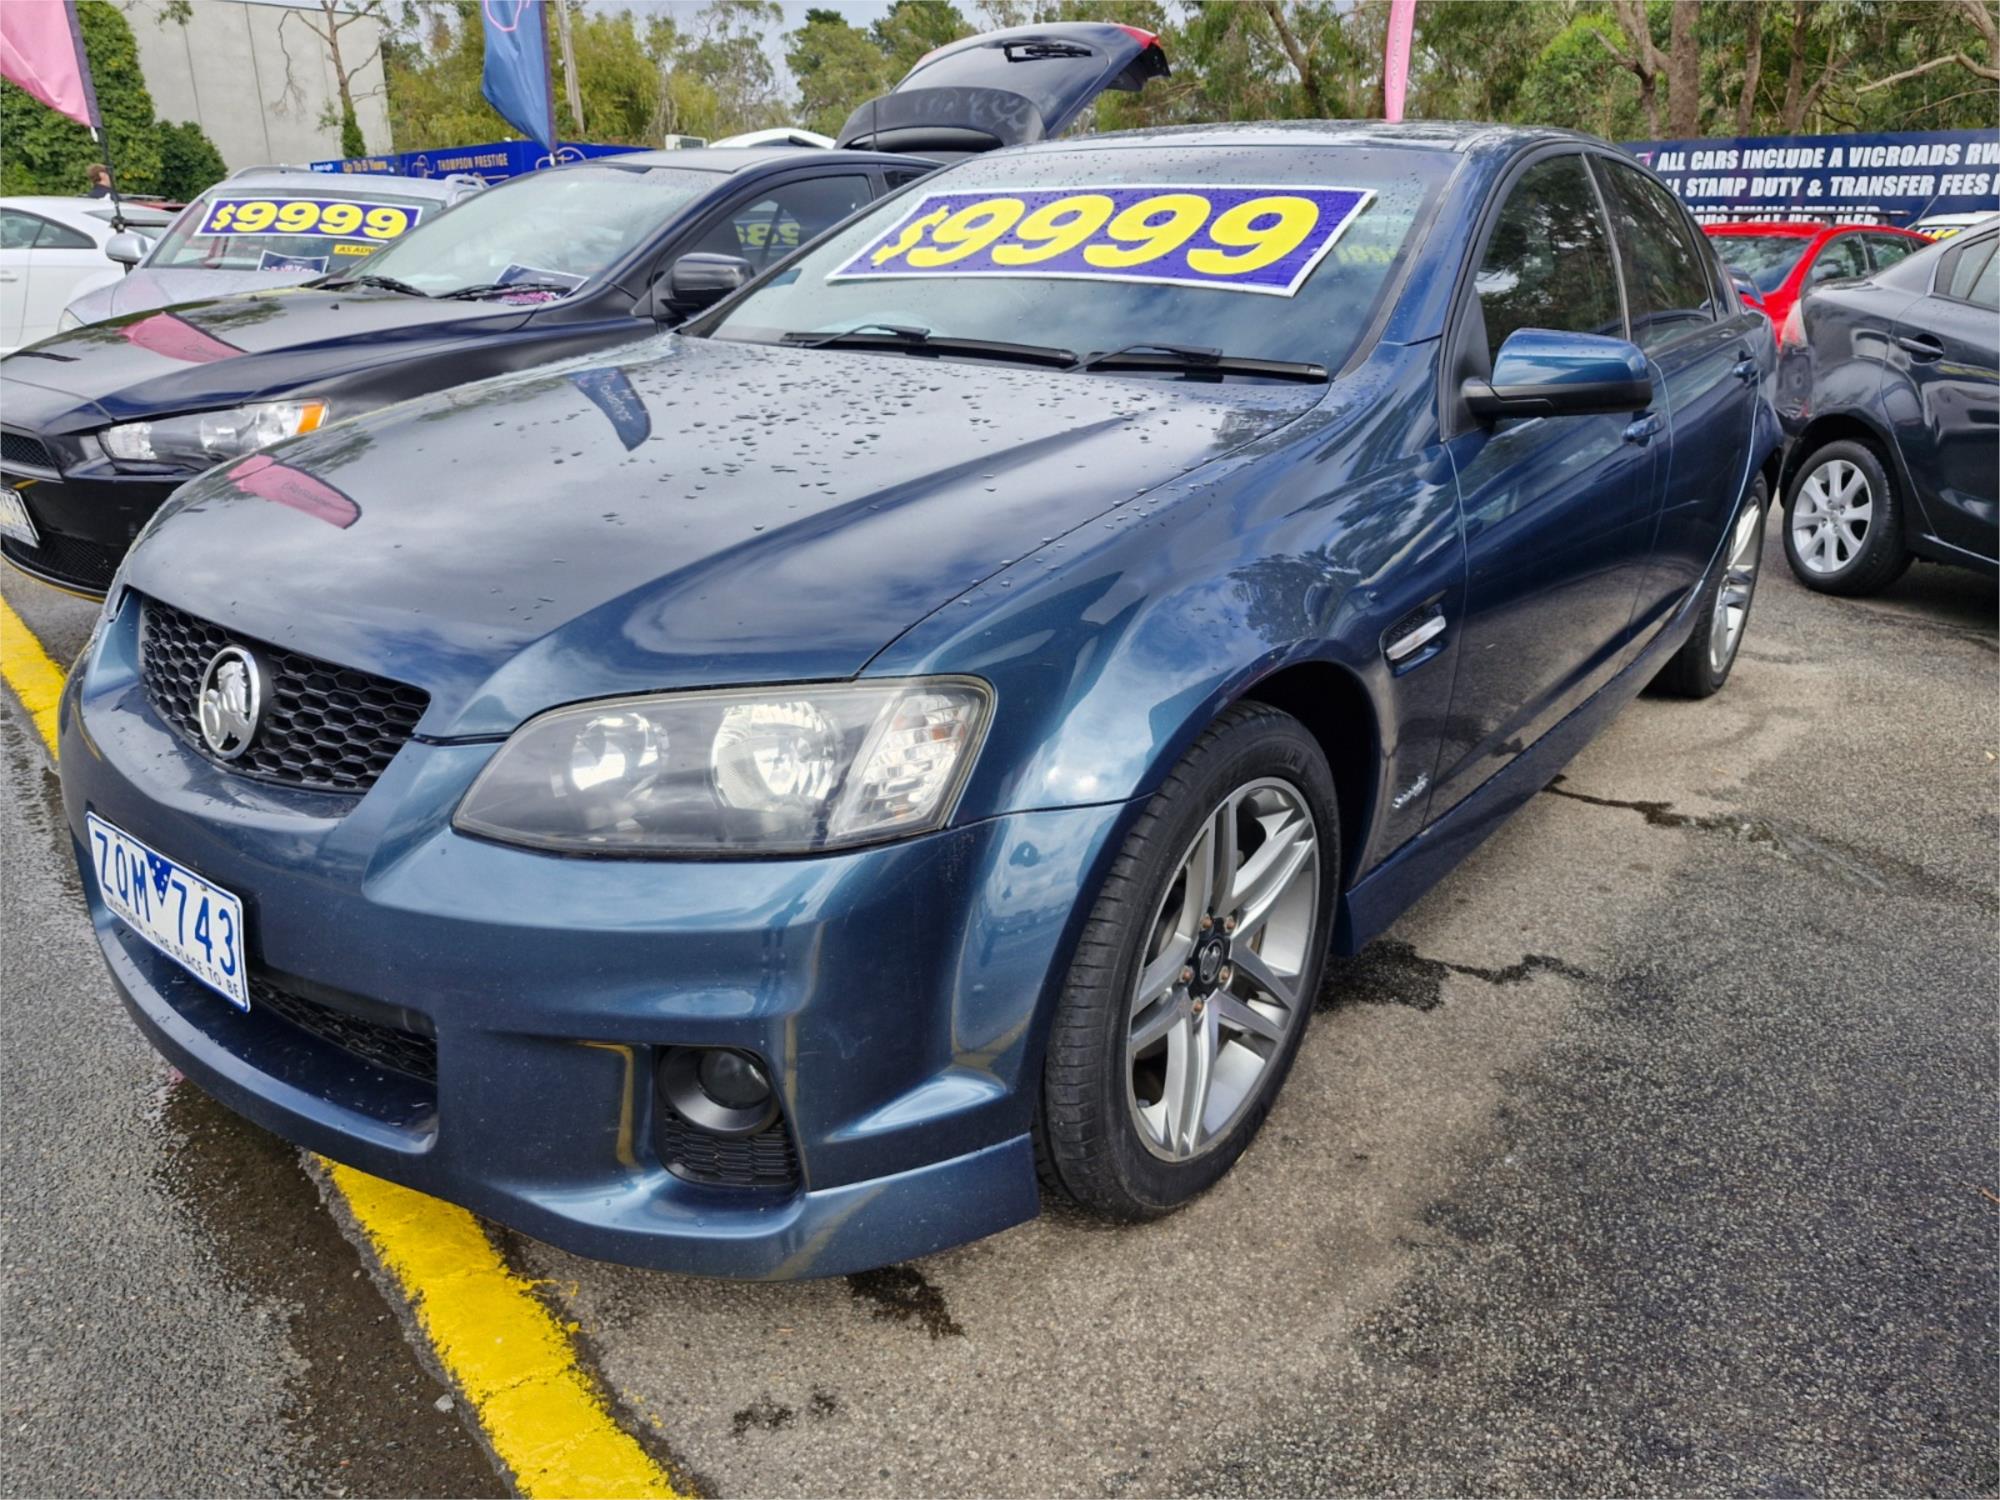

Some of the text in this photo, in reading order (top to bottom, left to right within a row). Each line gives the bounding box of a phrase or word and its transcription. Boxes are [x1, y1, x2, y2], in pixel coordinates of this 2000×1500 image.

[437, 153, 508, 171] THOMPSON PRESTIGE
[1656, 151, 1685, 171] ALL
[1690, 150, 1739, 170] CARS
[1742, 147, 1825, 169] INCLUDE
[1827, 147, 1844, 168] A
[1849, 143, 1961, 168] VICROADS
[1685, 176, 1747, 197] STAMP
[1750, 176, 1803, 197] DUTY
[1806, 178, 1824, 197] &
[1829, 175, 1936, 197] TRANSFER
[1938, 173, 1992, 196] FEES
[210, 200, 408, 240] $9999
[868, 193, 1320, 275] $9999
[171, 879, 237, 977] 743
[207, 966, 222, 986] TO
[226, 978, 241, 999] BE
